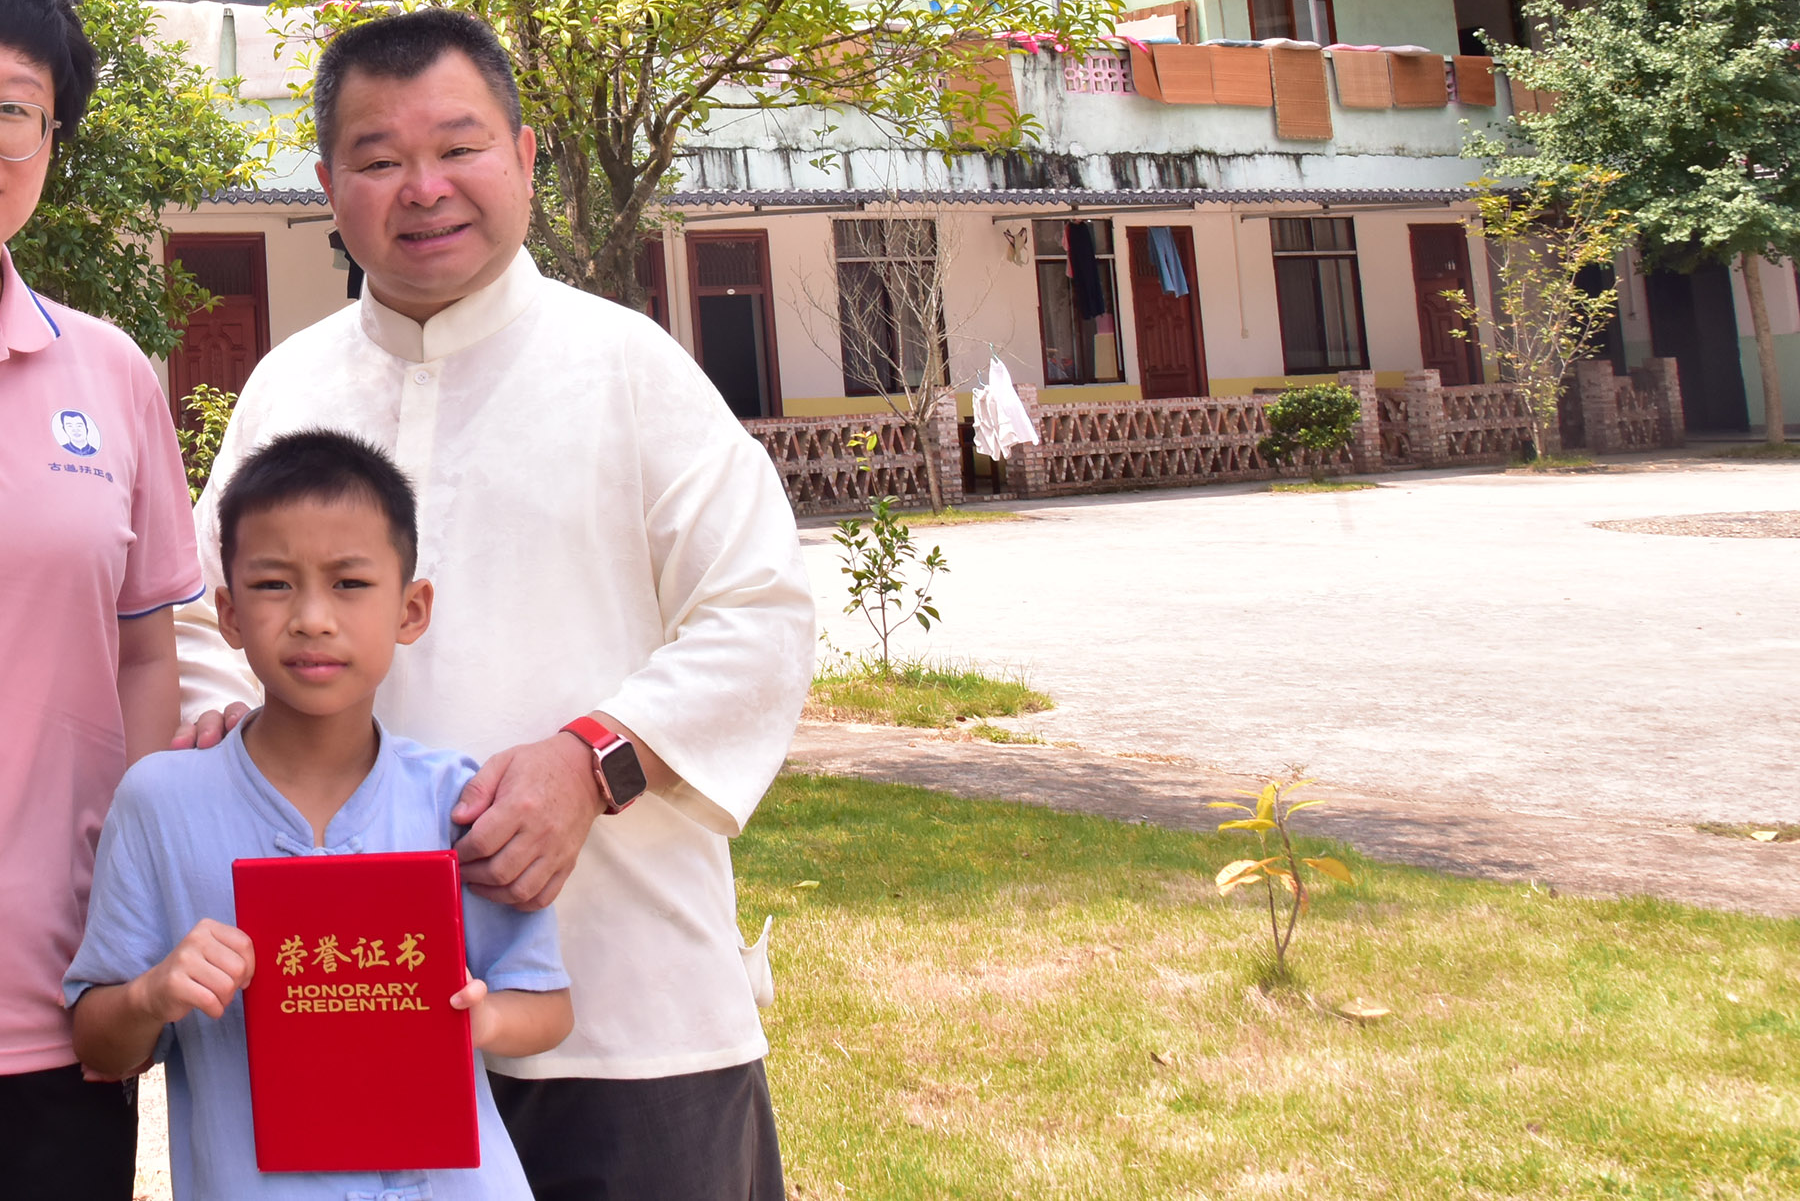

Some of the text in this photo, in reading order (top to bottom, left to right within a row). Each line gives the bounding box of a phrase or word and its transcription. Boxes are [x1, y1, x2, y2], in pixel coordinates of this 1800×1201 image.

[276, 933, 426, 976] 荣誉证书
[287, 982, 420, 998] HONORARY
[280, 997, 430, 1013] CREDENTIAL
